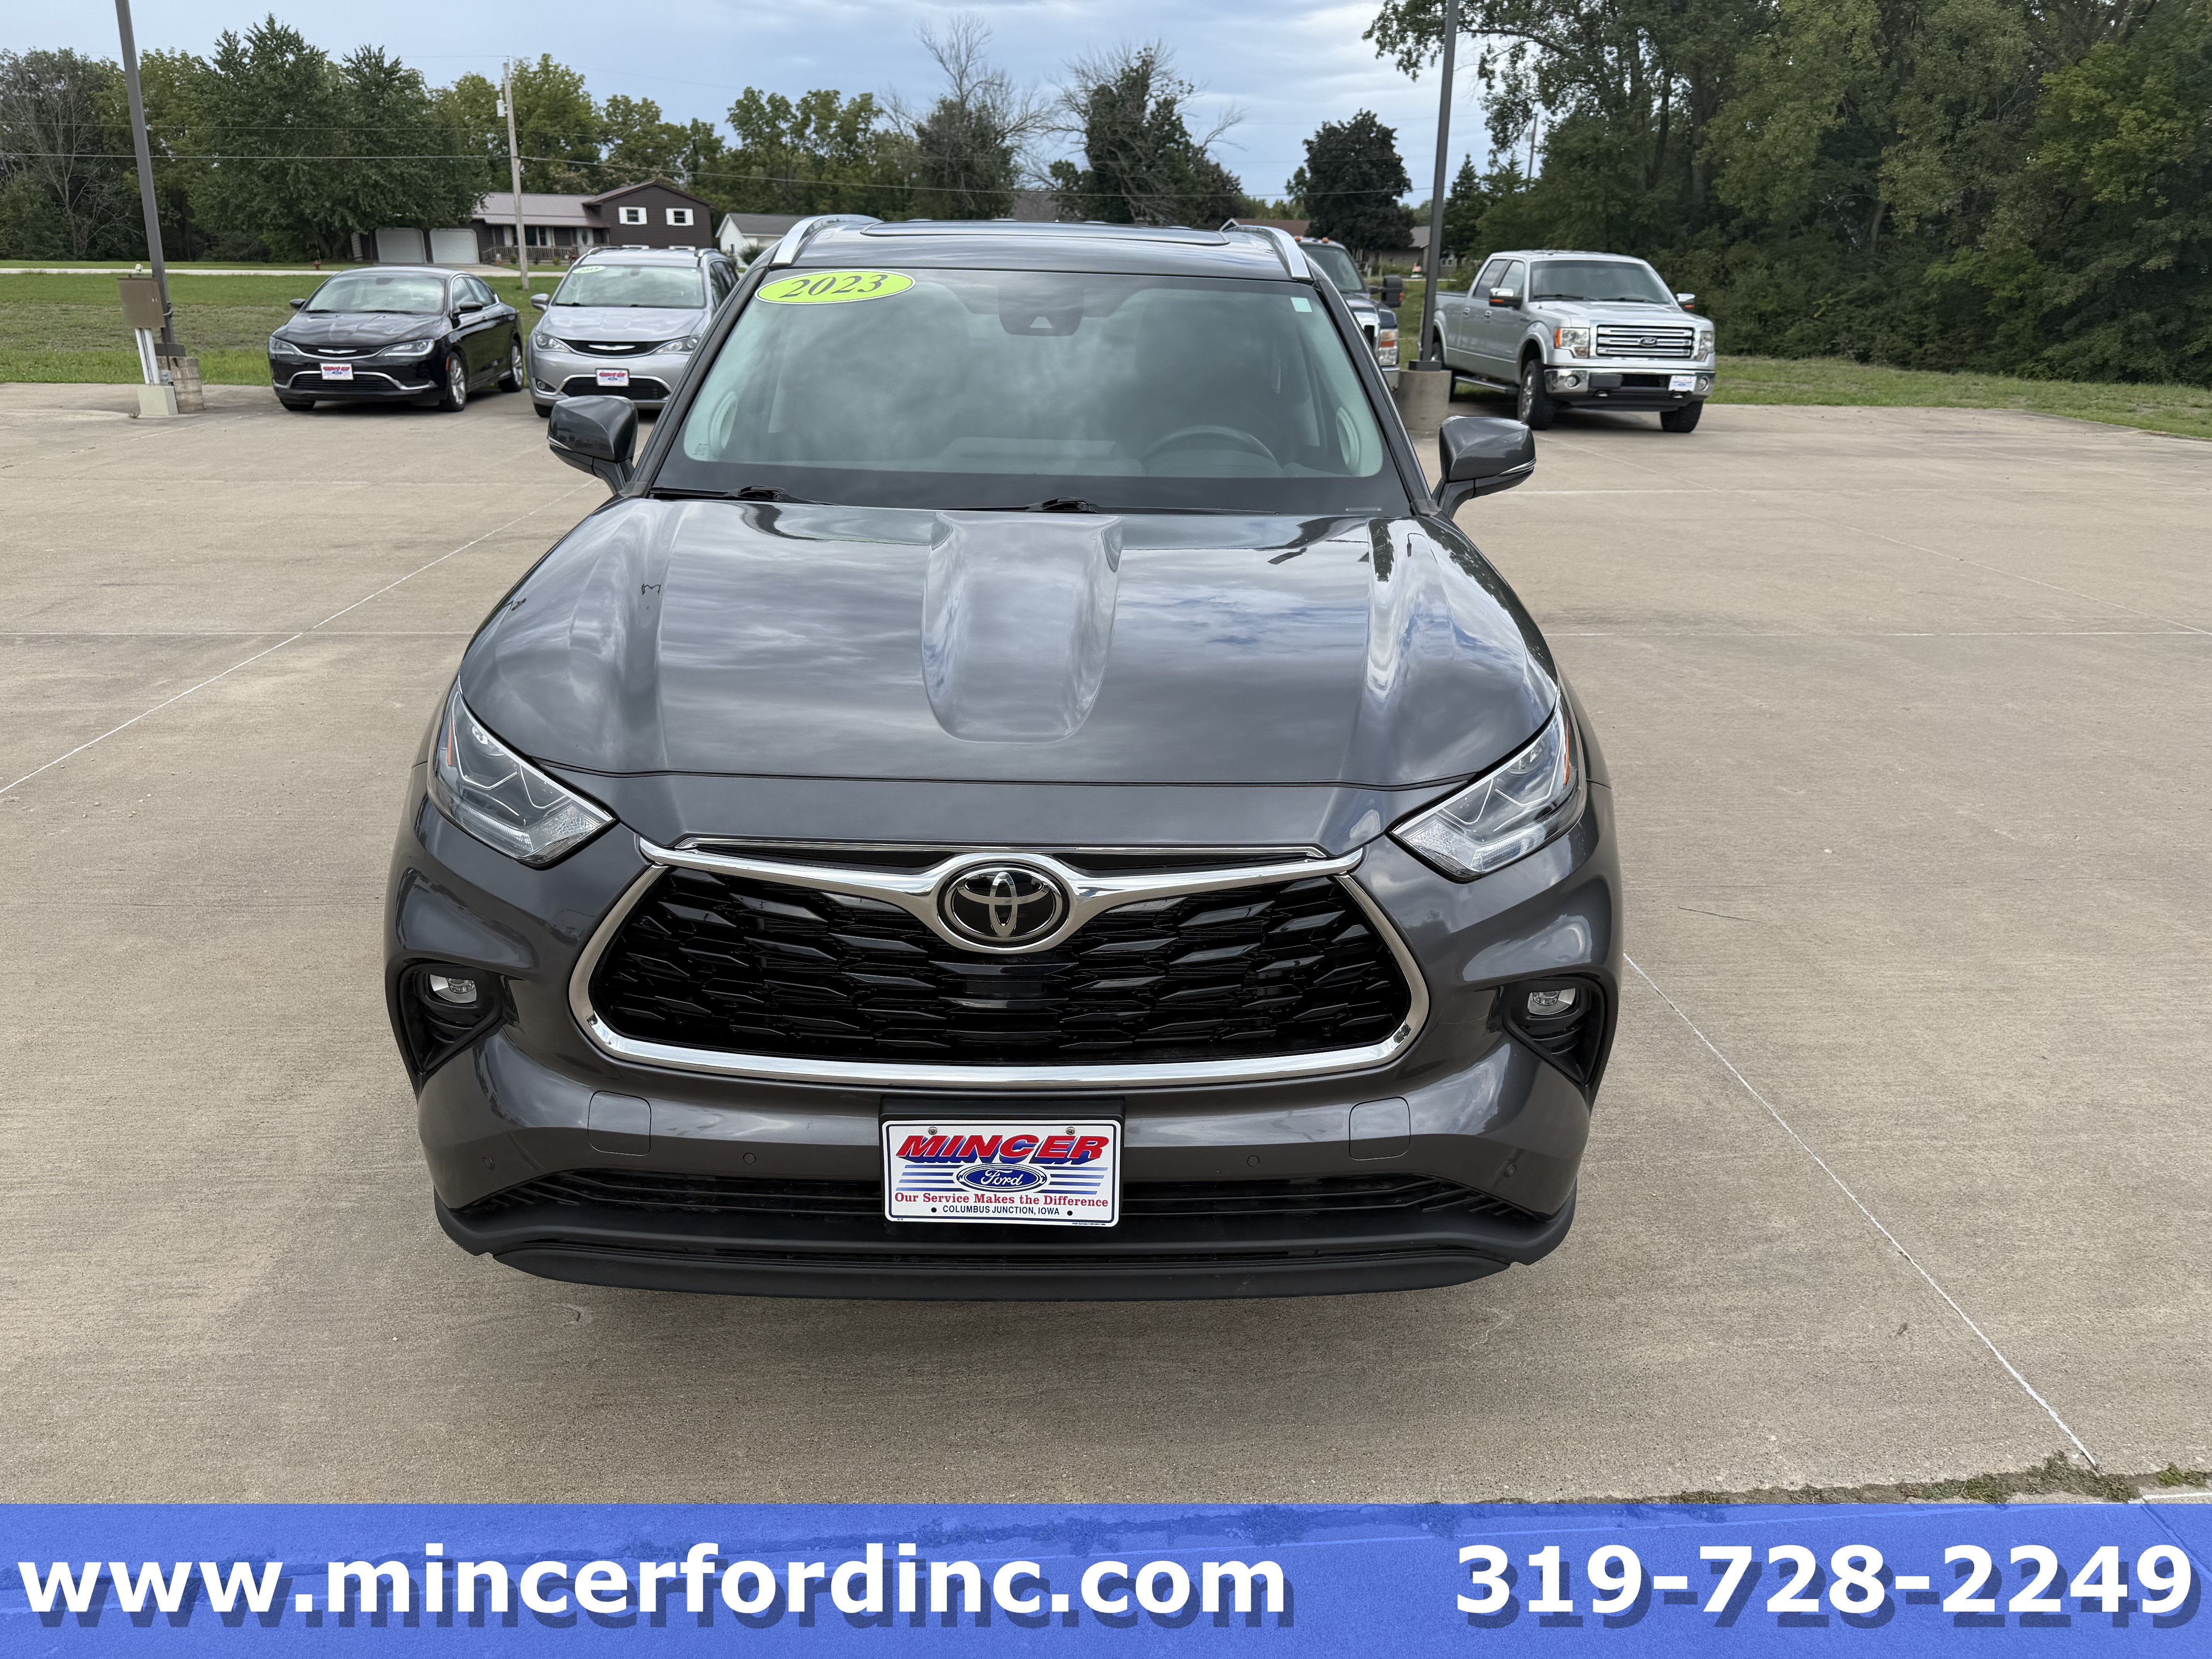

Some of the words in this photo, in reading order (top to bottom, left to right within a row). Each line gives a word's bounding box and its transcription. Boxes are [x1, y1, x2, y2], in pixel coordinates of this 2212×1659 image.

[778, 274, 888, 299] 2023
[895, 1134, 1109, 1164] MINCER
[981, 1169, 1024, 1185] Ford
[895, 1192, 919, 1202] Our
[923, 1193, 970, 1203] Service
[974, 1193, 1015, 1204] Makes
[1019, 1195, 1040, 1204] the
[1043, 1195, 1108, 1207] Difference
[943, 1205, 990, 1213] COLUMBUS
[992, 1206, 1036, 1216] JUNCTION,
[1038, 1207, 1060, 1215] IOWA
